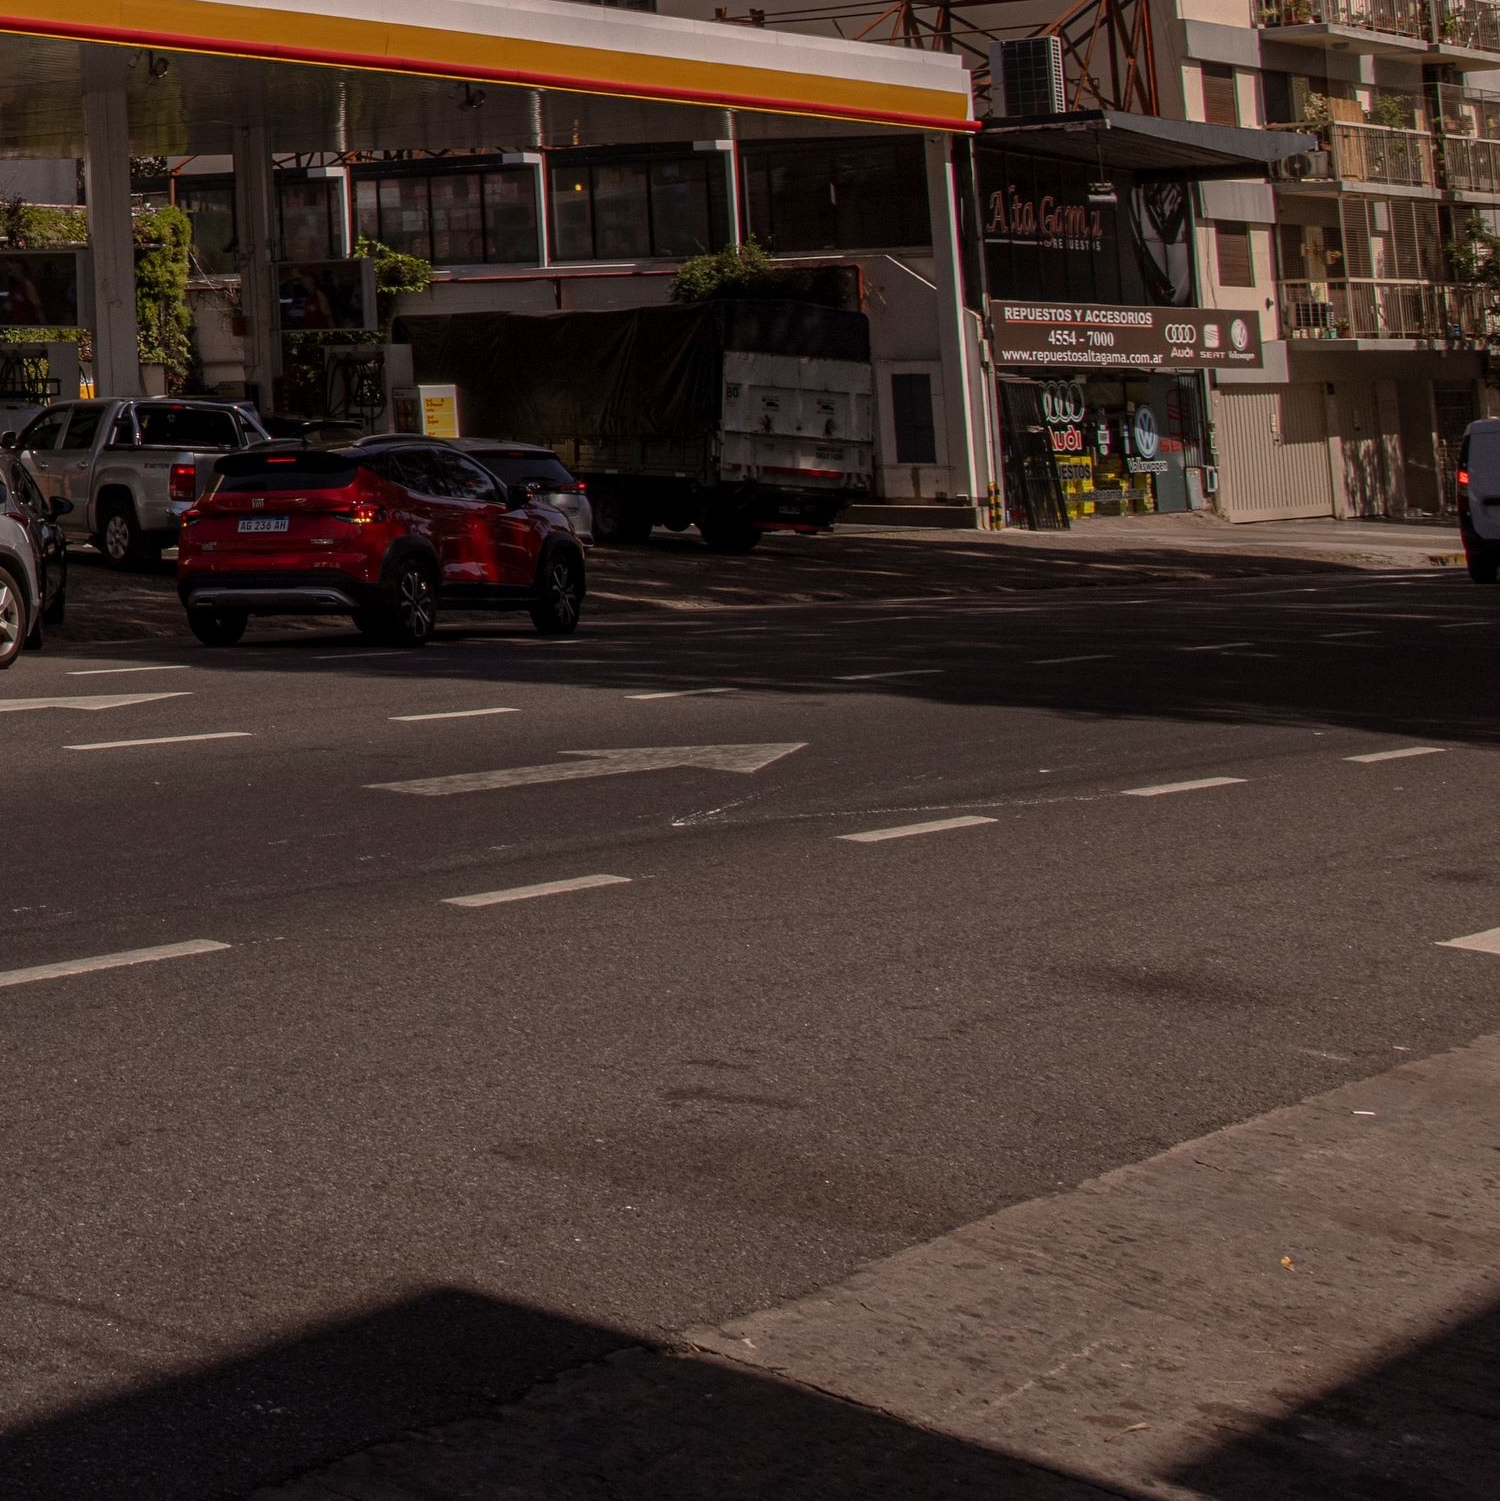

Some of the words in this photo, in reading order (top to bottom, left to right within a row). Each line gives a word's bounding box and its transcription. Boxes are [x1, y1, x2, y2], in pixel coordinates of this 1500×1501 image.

[1004, 306, 1072, 322] REPUESTOS
[1074, 309, 1083, 322] Y
[1085, 310, 1153, 325] ACCESORIOS
[1048, 330, 1077, 346] 4554
[1087, 331, 1115, 347] 7000
[1002, 349, 1164, 365] www.repuestosaltagama.com.ar
[1170, 346, 1194, 358] Audi
[1199, 351, 1226, 359] SEAT
[240, 521, 252, 531] AG
[255, 521, 271, 530] 236
[274, 520, 287, 530] AH
